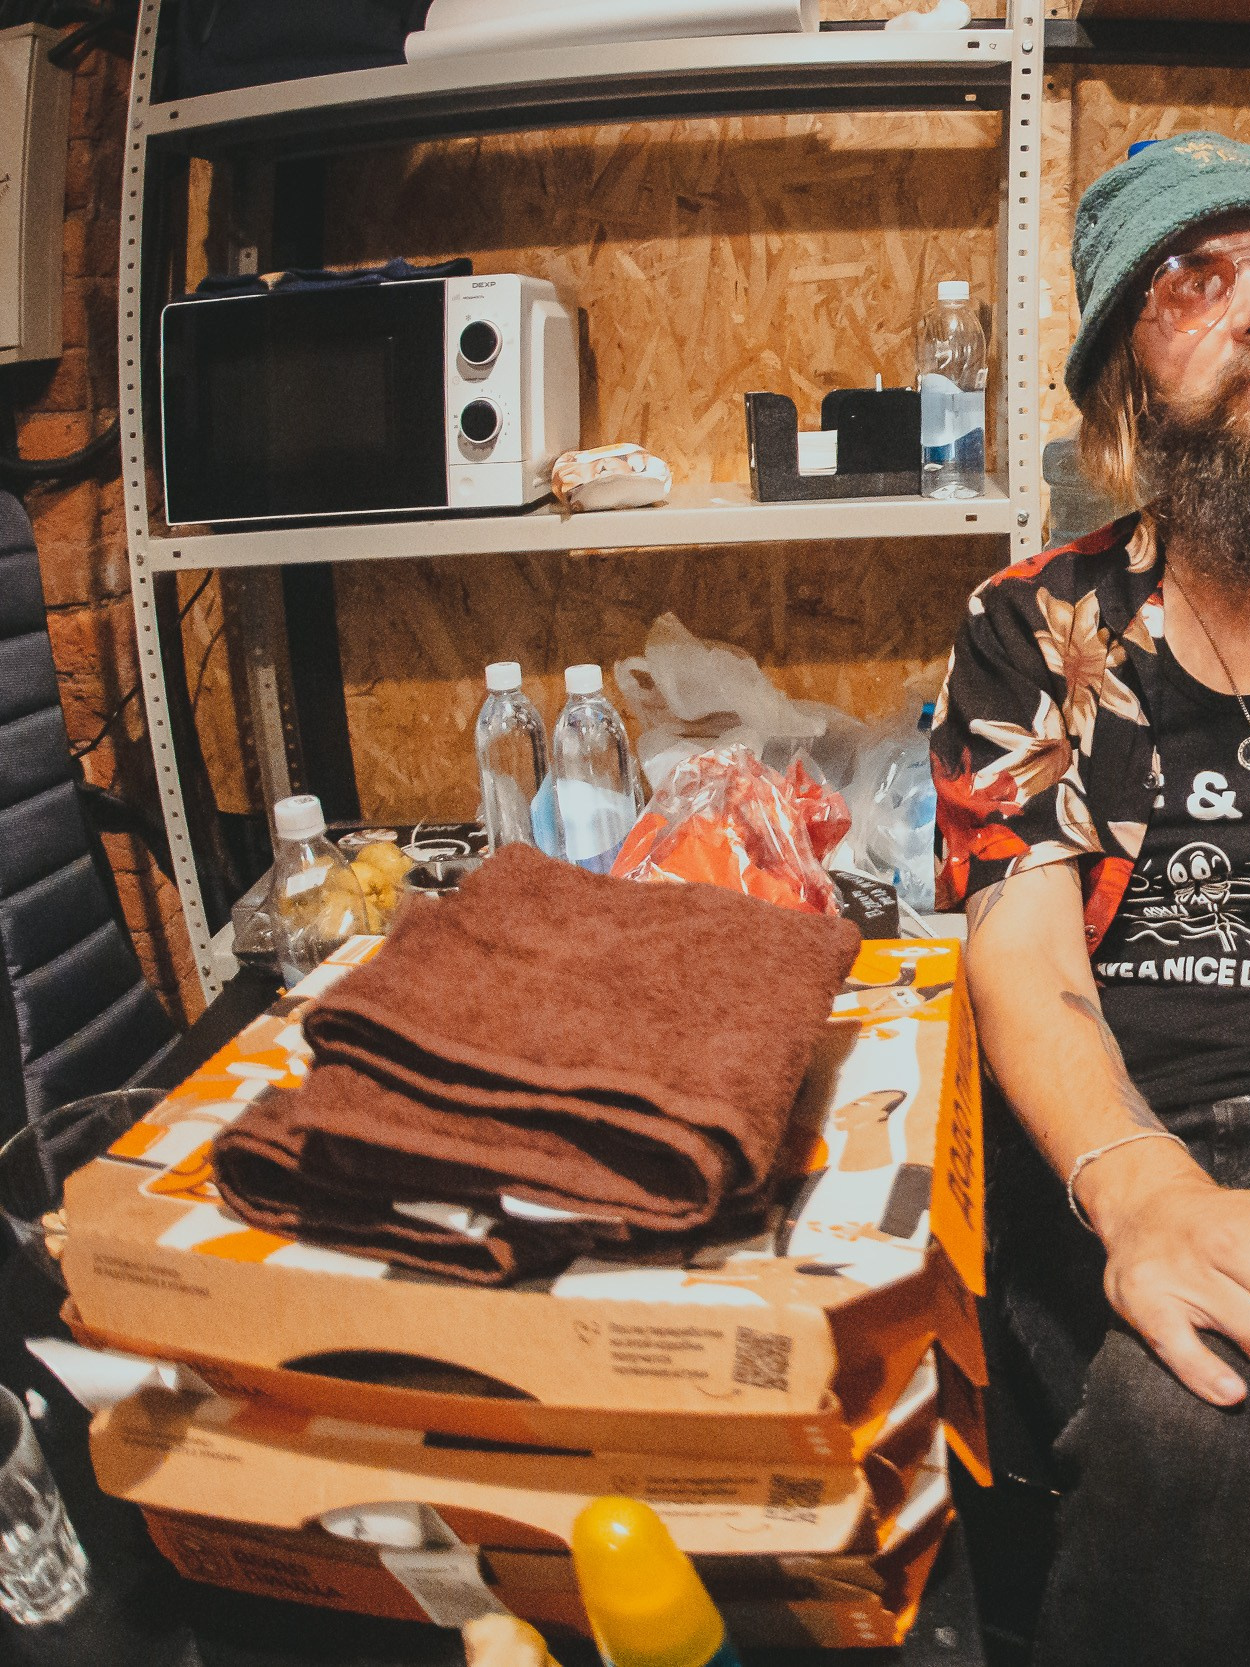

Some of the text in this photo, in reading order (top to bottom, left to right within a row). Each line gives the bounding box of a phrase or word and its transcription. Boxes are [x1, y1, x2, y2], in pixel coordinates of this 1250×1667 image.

[472, 281, 497, 289] DEXP
[1186, 771, 1243, 820] &
[1138, 960, 1159, 981] A
[1163, 956, 1236, 986] NICE
